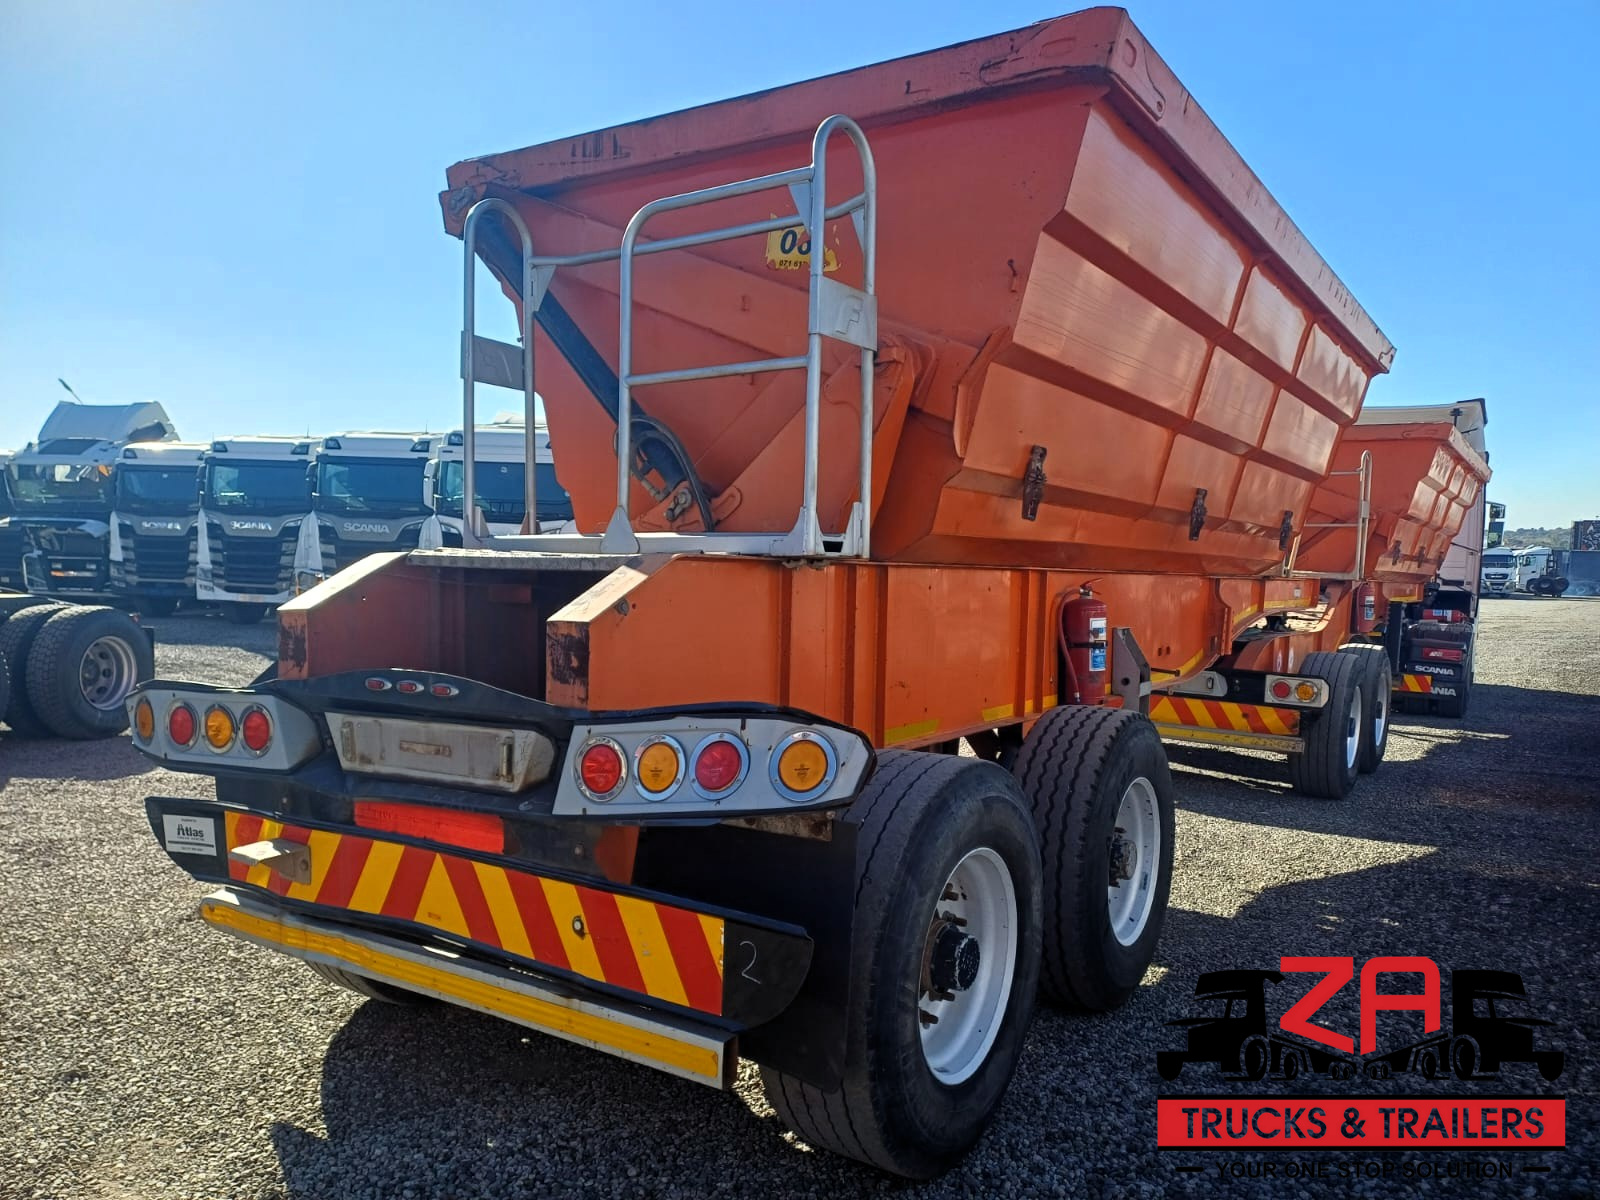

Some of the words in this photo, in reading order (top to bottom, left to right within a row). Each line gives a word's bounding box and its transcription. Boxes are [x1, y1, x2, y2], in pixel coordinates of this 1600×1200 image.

[231, 520, 273, 531] SCANIA
[343, 522, 390, 534] SCANIA
[1415, 665, 1454, 675] SCANIA
[1430, 687, 1456, 696] ANIA
[177, 823, 205, 838] Atlas
[739, 940, 762, 985] 2
